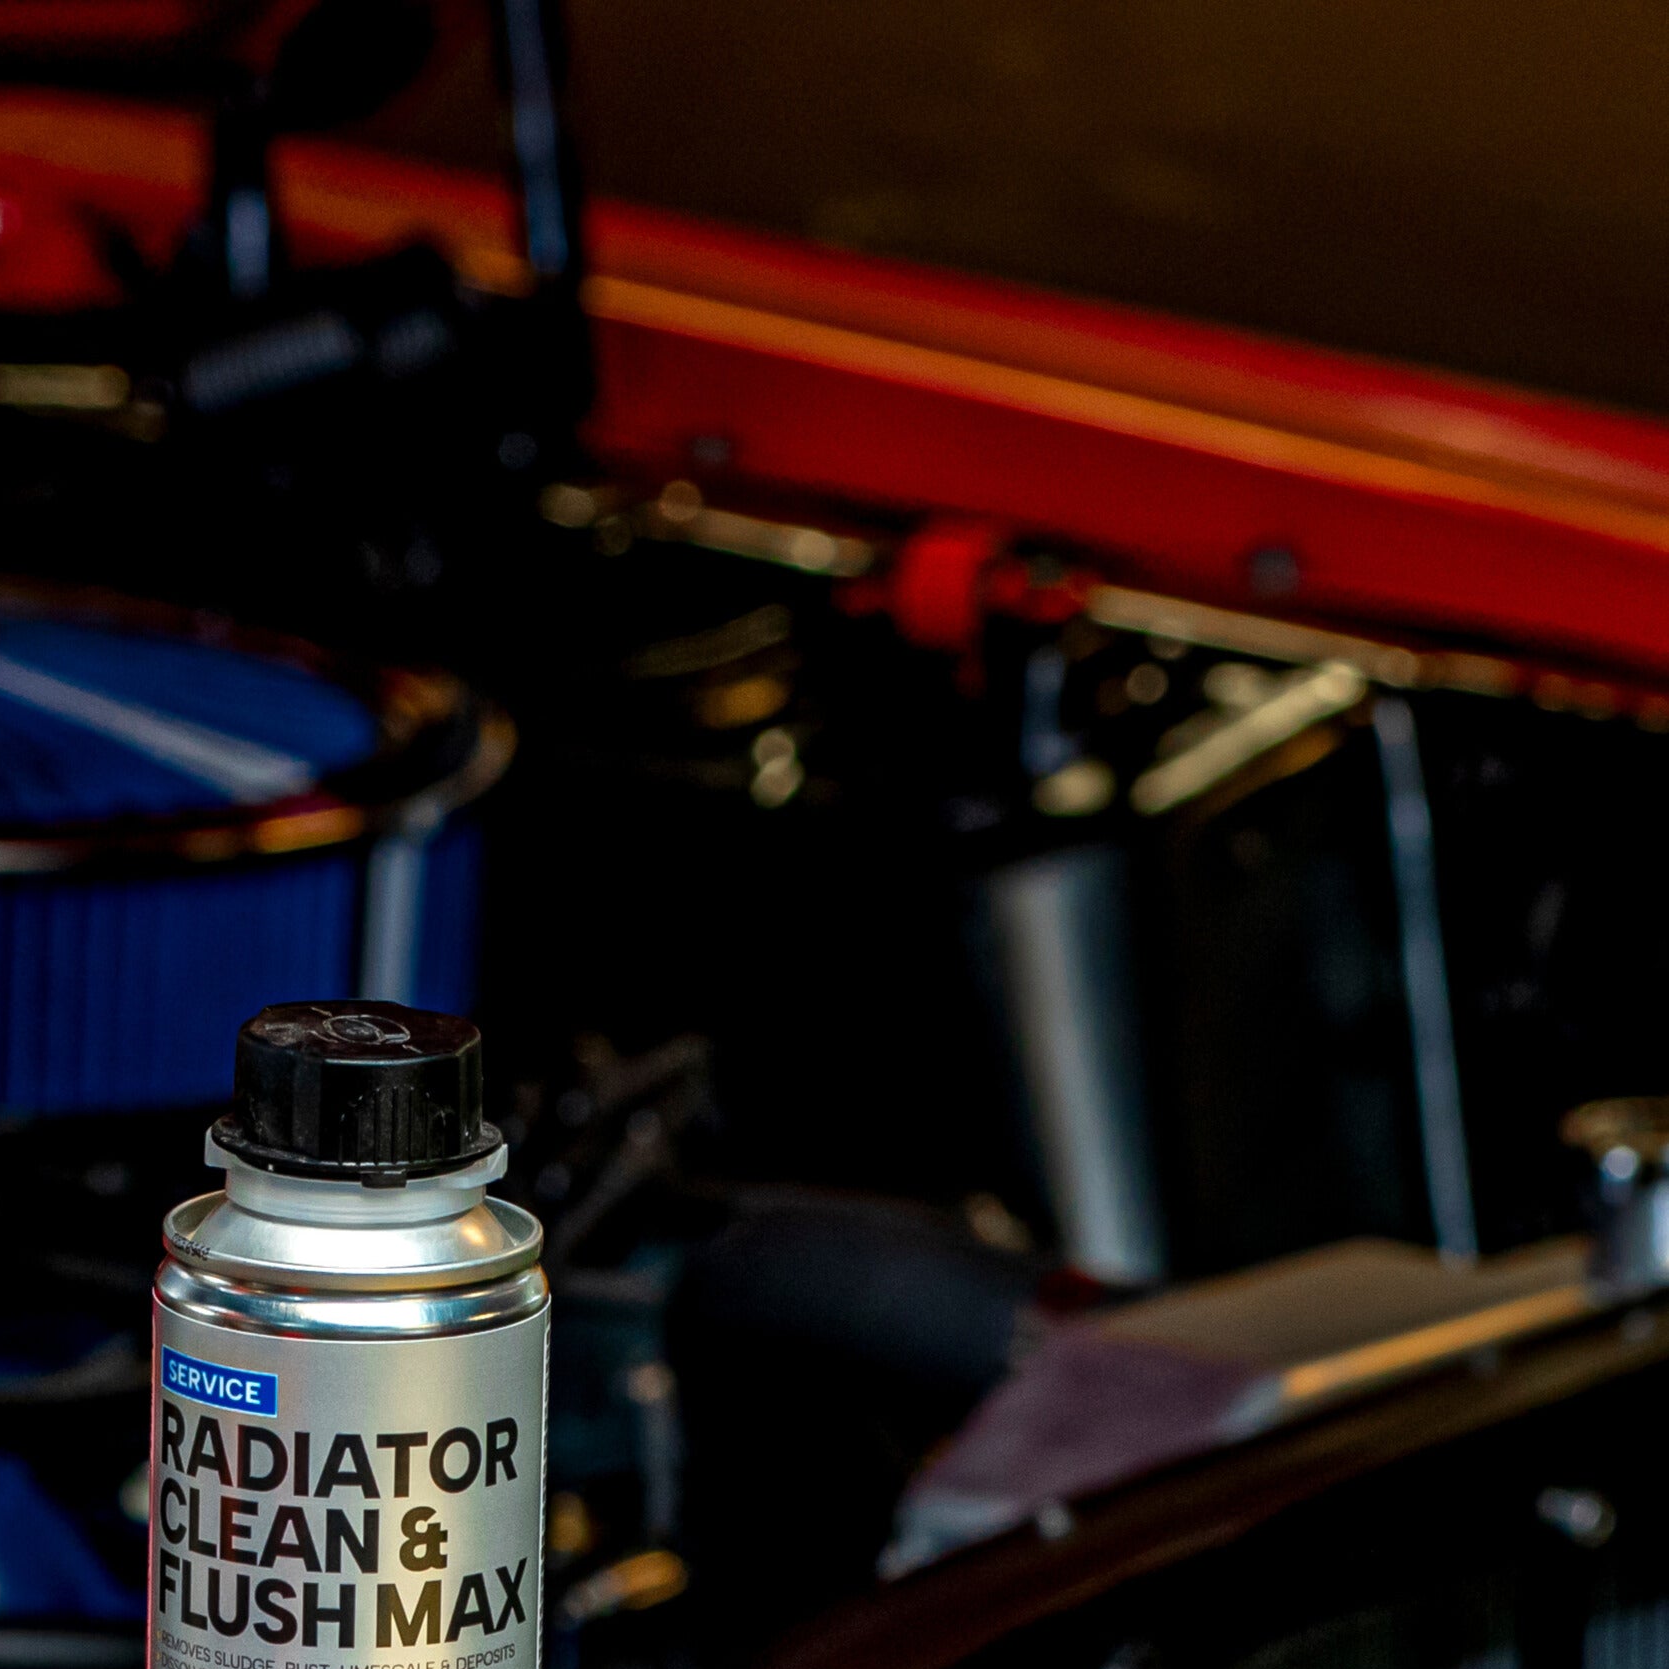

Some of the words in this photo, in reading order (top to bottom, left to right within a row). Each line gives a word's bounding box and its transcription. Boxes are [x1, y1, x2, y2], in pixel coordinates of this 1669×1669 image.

[169, 1359, 261, 1405] SERVICE
[161, 1399, 518, 1499] RADIATOR
[160, 1478, 379, 1573] CLEAN
[399, 1506, 448, 1571] &
[159, 1548, 356, 1648] FLUSH
[376, 1557, 527, 1648] MAX
[161, 1630, 210, 1662] REMOVES
